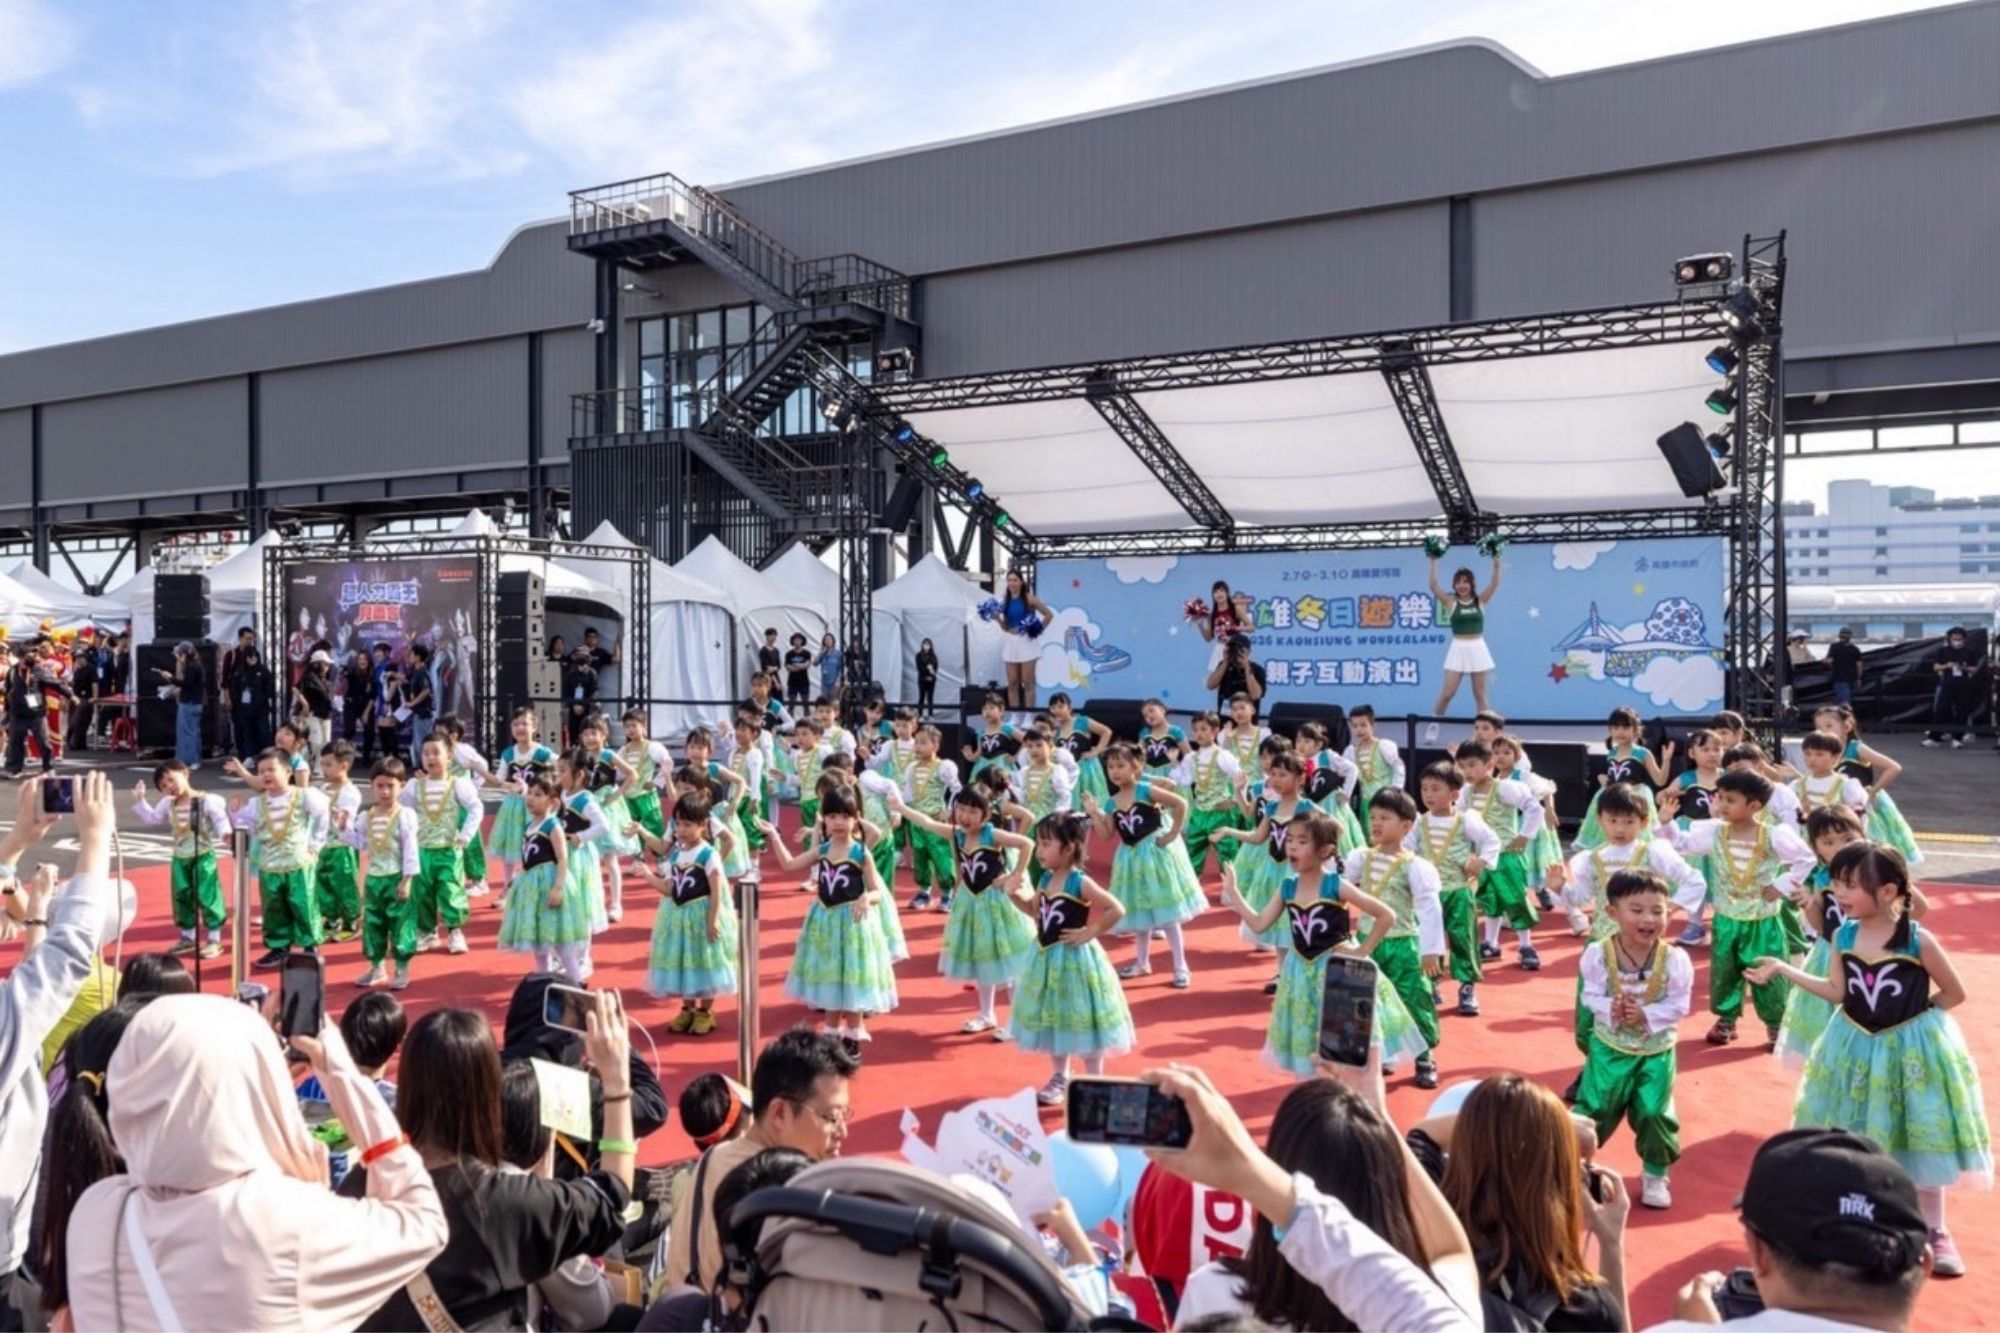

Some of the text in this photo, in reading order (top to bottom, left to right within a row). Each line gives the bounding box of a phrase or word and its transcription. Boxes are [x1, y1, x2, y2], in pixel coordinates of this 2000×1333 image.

[1232, 592, 1451, 630] 雄冬日遊樂
[1250, 634, 1446, 647] 026 KAOHSIUNG WONDERLAND
[1265, 659, 1419, 685] 親子互動演出
